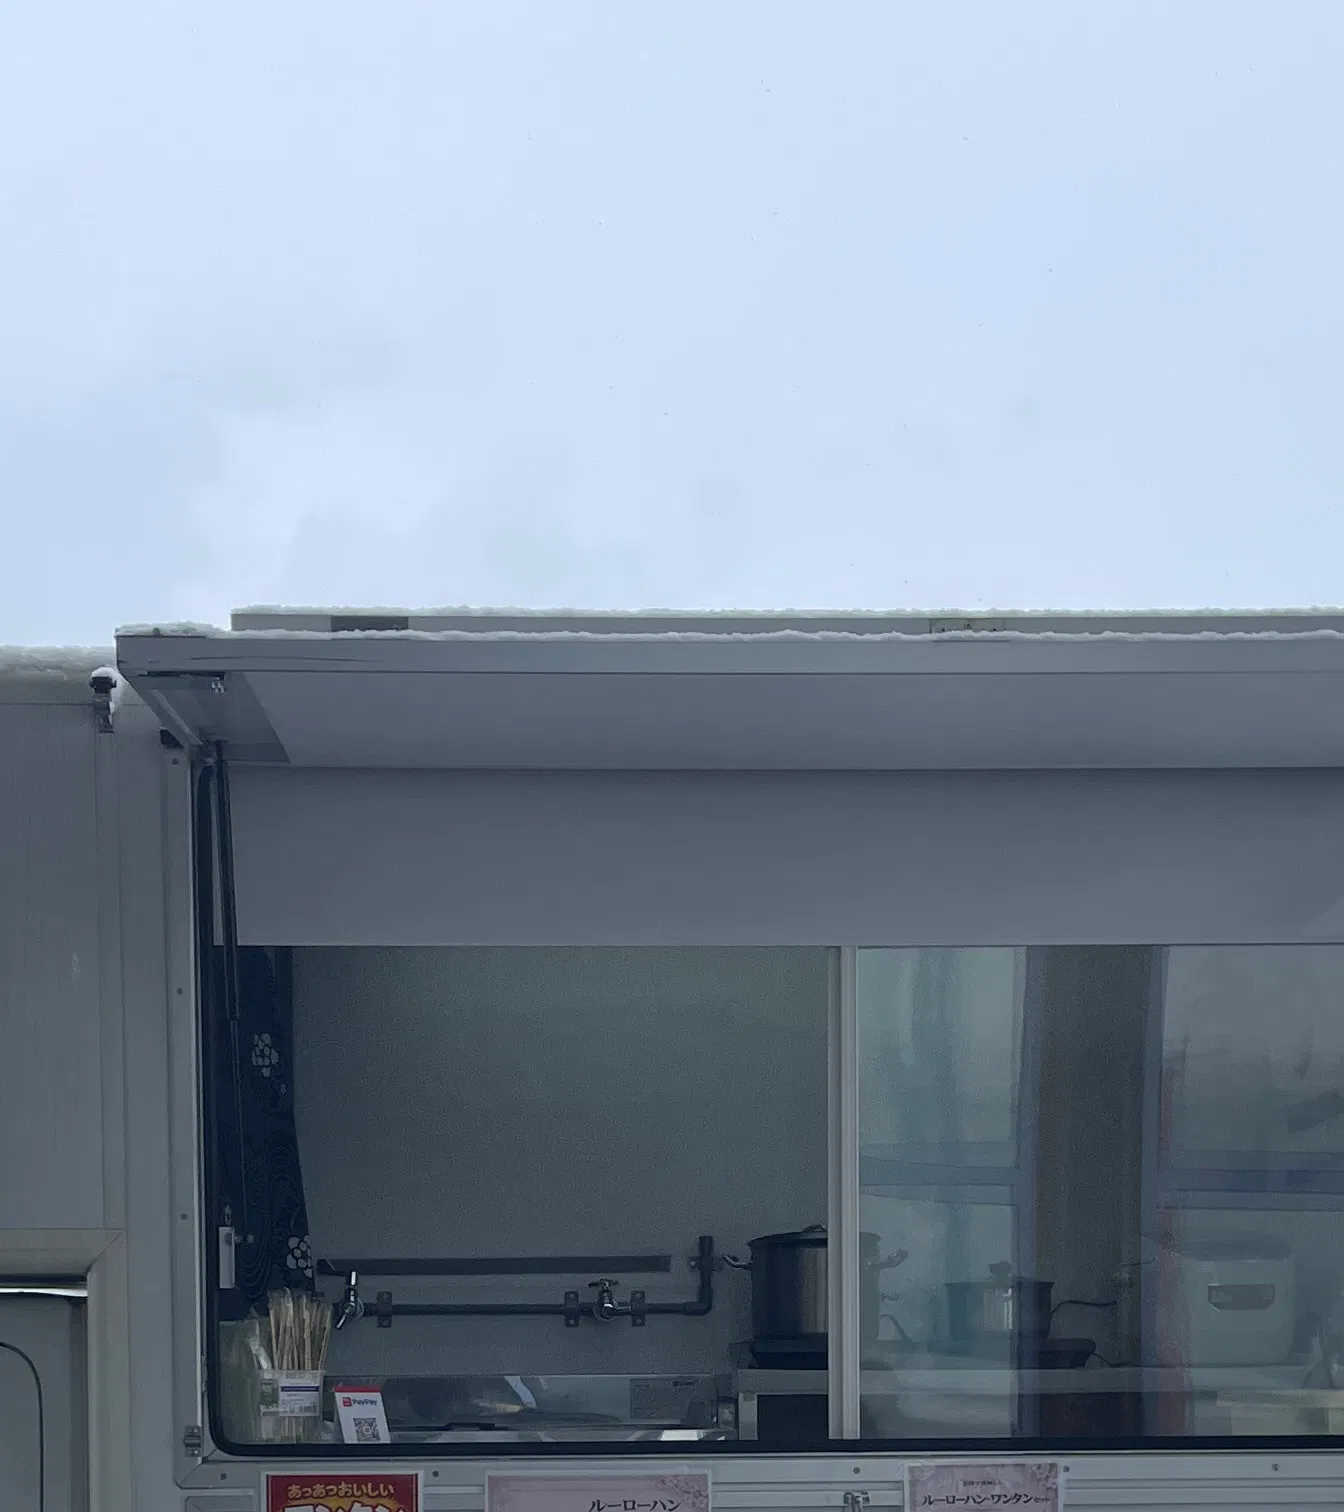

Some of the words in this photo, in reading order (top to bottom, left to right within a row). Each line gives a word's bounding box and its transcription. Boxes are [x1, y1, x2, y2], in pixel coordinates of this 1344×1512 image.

[588, 1498, 681, 1512] ルーローハン
